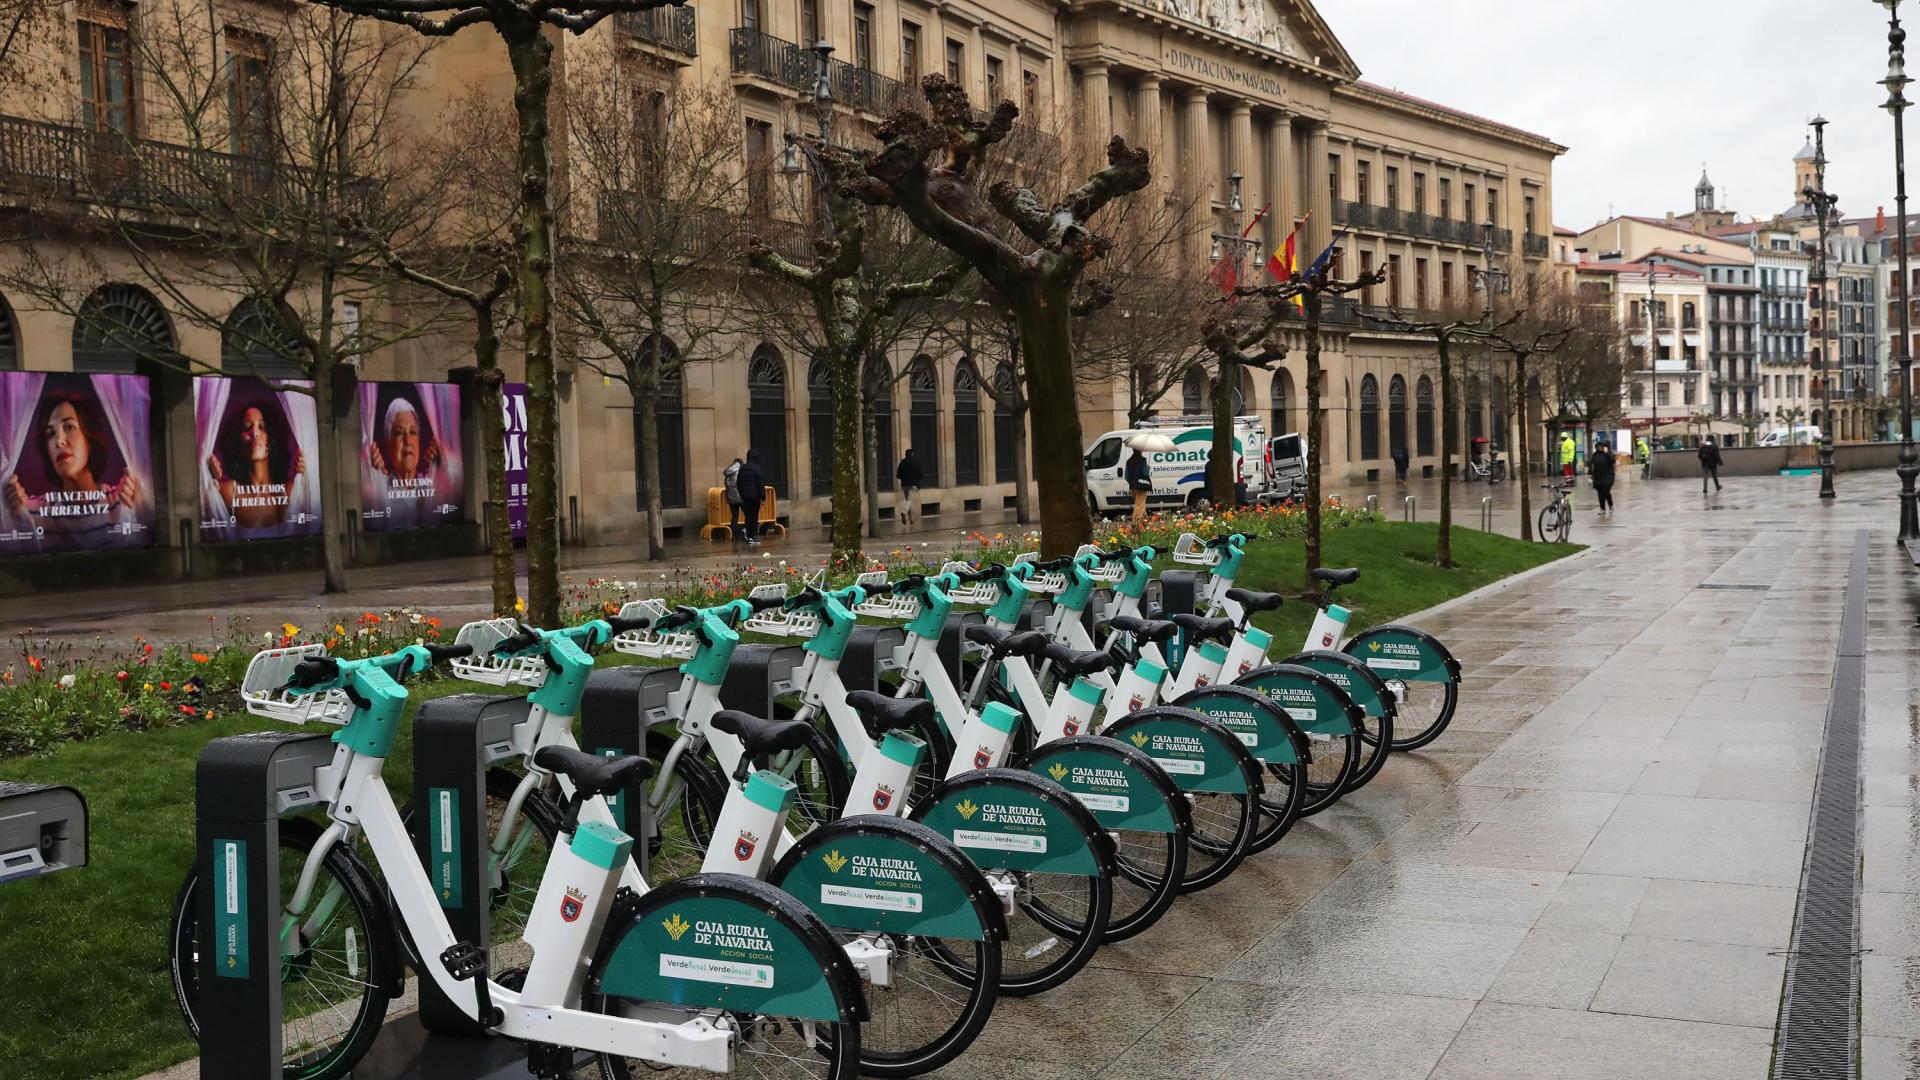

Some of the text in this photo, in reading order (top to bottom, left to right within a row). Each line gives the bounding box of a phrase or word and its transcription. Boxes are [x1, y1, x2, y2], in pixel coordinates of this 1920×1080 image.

[1243, 72, 1282, 97] NAVARRA
[1153, 447, 1206, 463] conat
[1153, 464, 1205, 472] telecomunicac
[1282, 695, 1317, 703] NAVARRA
[1209, 710, 1254, 719] CAJA RURAL
[1221, 718, 1258, 726] NAVARRA
[1152, 735, 1202, 745] CAJA RURAL
[1152, 742, 1205, 753] DE NAVARRA
[1072, 767, 1126, 779] CAJA RURAL
[1072, 775, 1129, 787] DE NAVARRA
[983, 804, 1042, 817] CAJA RURAL
[982, 813, 1047, 826] DE NAVARRA
[852, 855, 918, 871] CAJA RURAL
[852, 866, 923, 881] DE NAVARRA
[695, 921, 769, 939] CAJA RURAL
[694, 933, 774, 952] DE NAVARRA
[748, 952, 774, 961] SOCIAL
